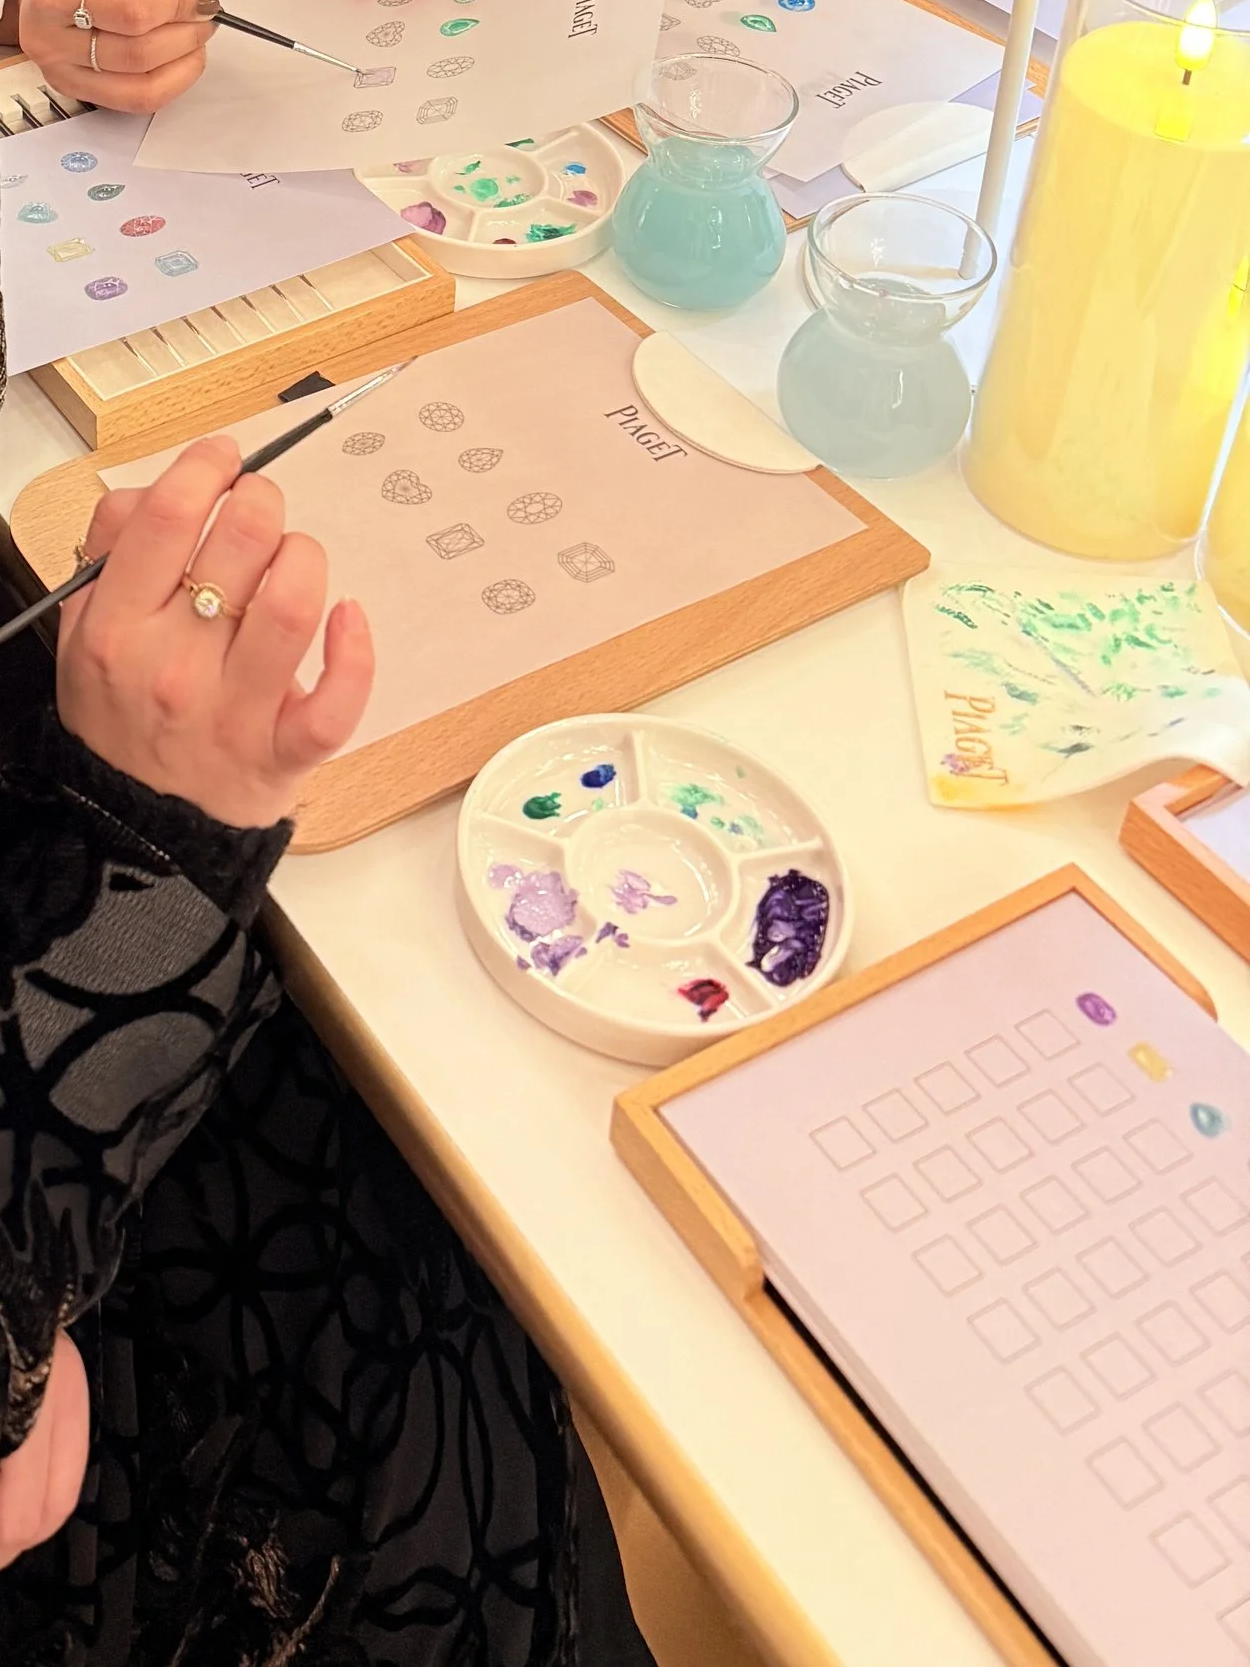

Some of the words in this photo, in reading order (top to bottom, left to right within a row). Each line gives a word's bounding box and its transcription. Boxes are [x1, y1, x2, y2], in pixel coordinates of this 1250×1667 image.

[815, 70, 883, 110] PIAGET
[603, 404, 688, 462] PIAGET
[943, 689, 1010, 787] PIAGET
